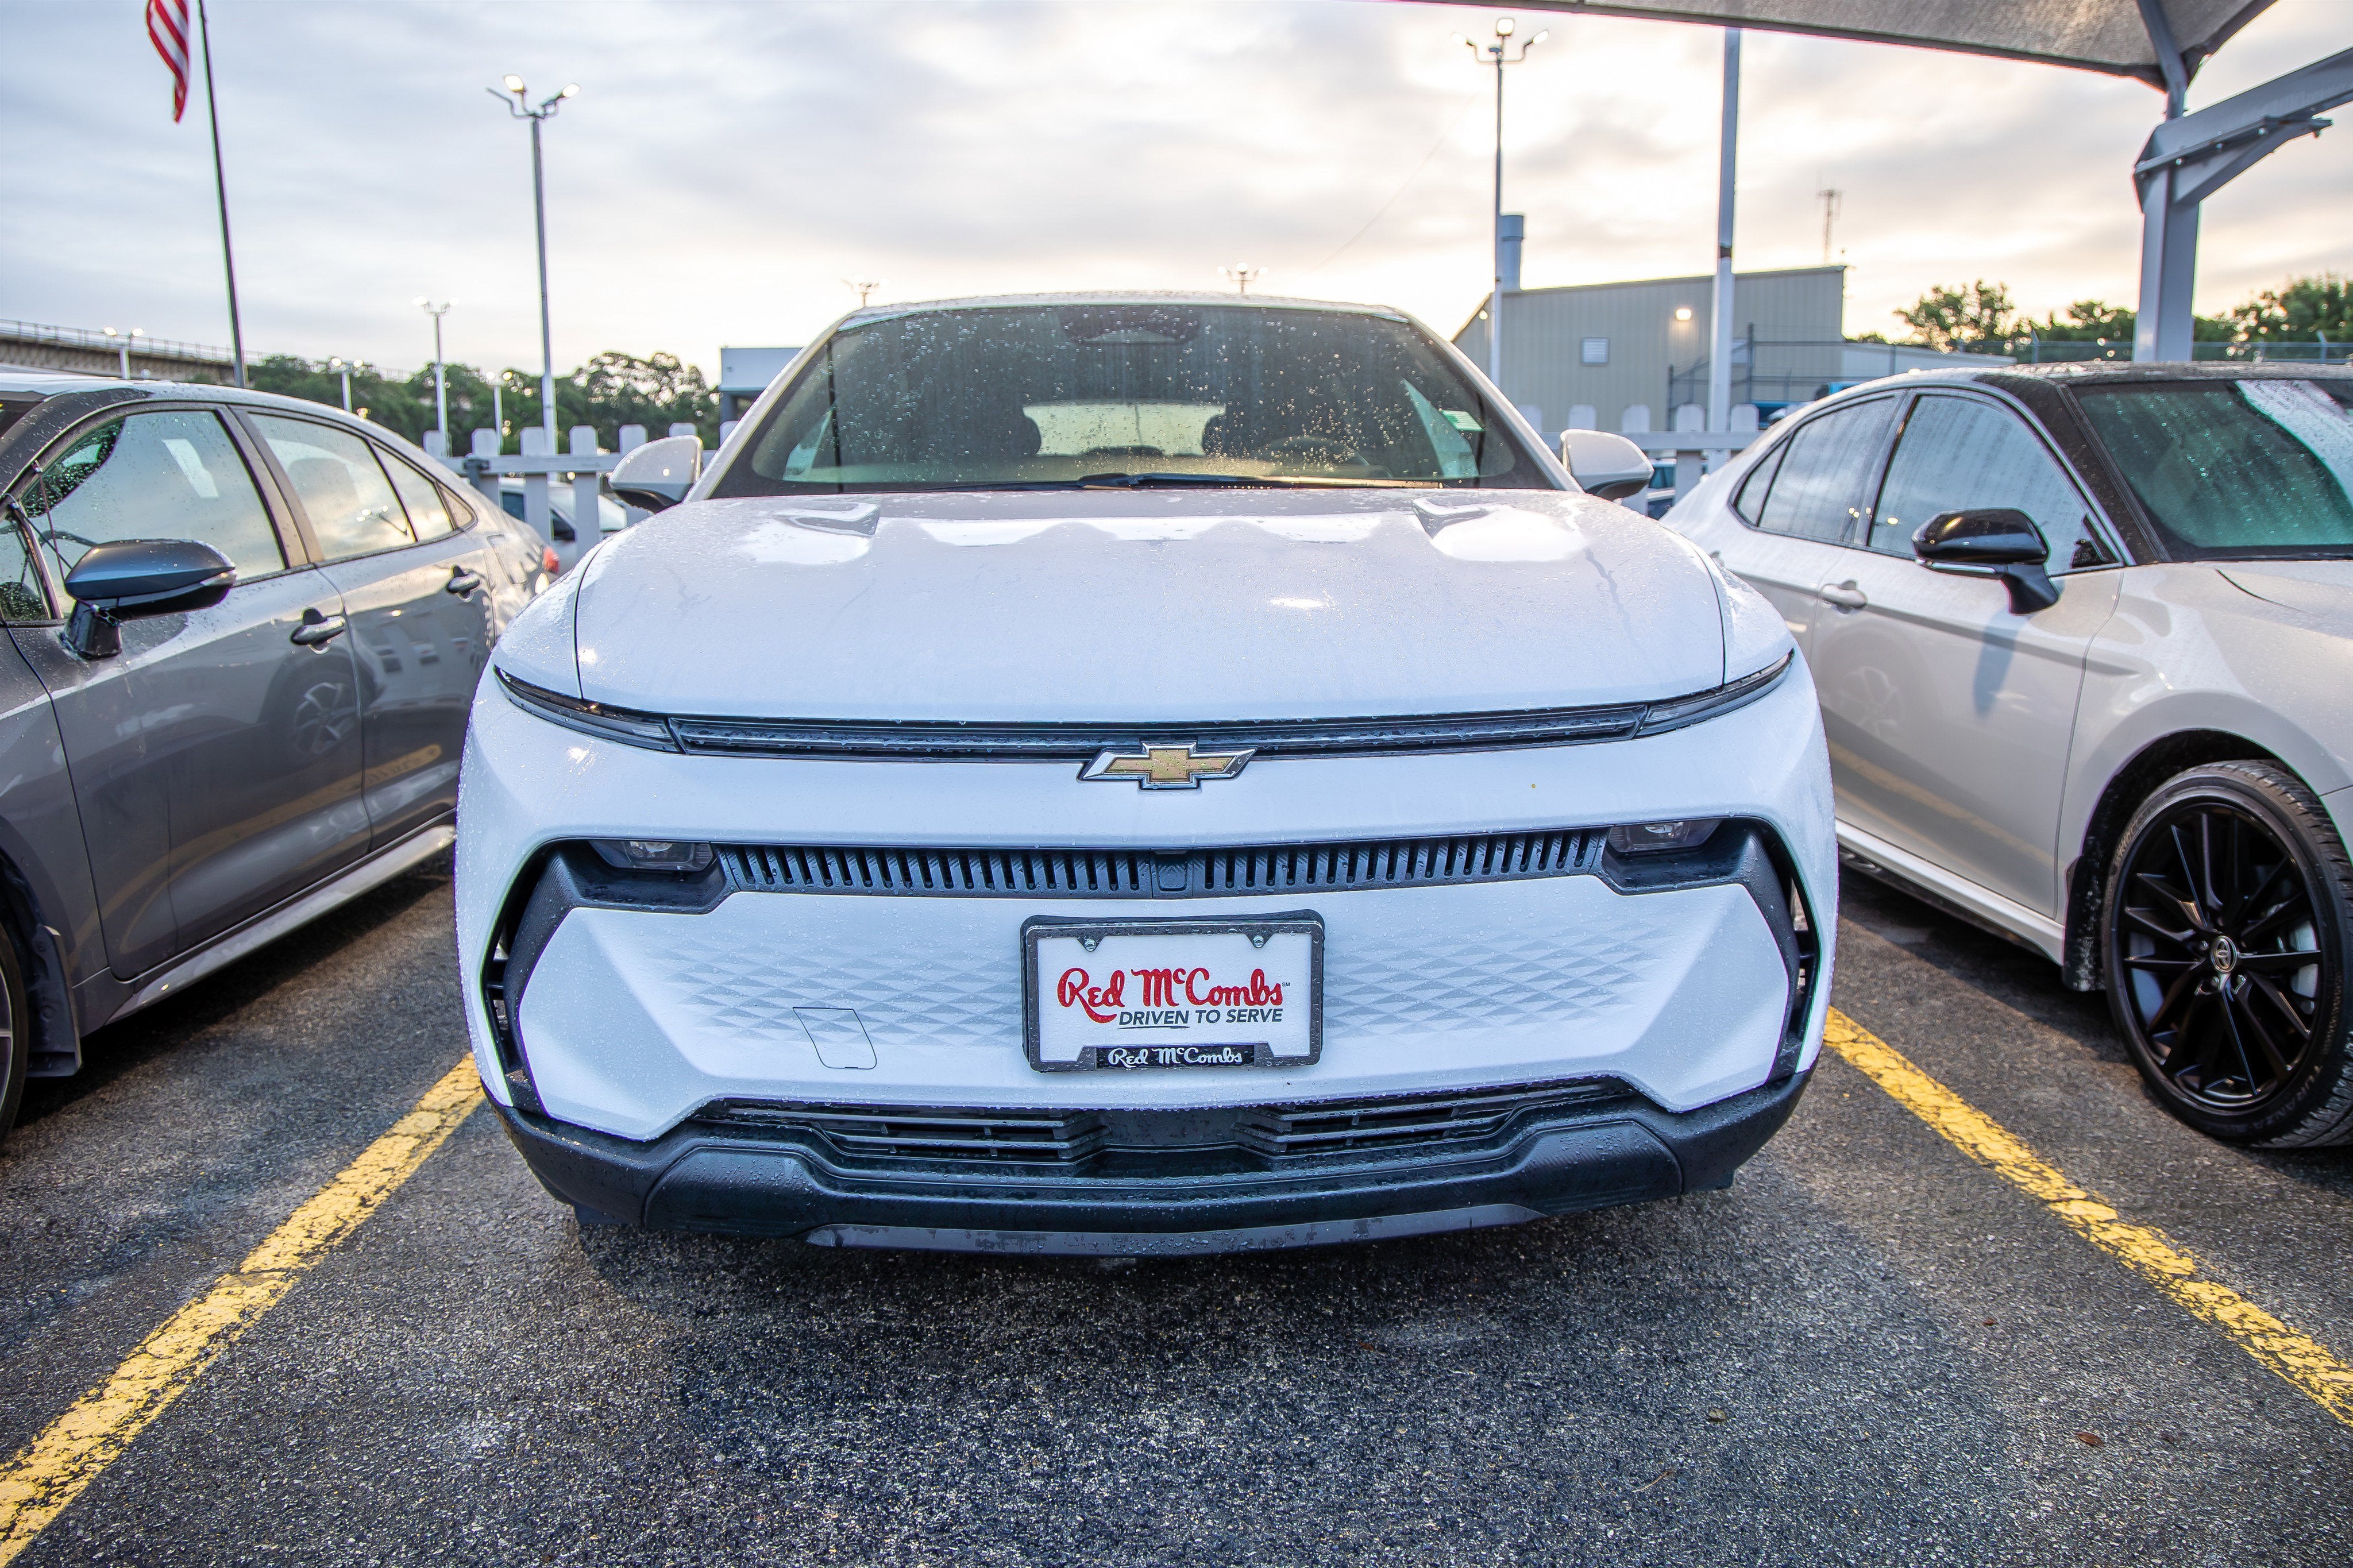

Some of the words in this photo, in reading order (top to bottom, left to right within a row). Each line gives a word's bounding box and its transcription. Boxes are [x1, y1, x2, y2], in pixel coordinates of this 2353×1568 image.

[1057, 968, 1125, 1024] Red
[1131, 968, 1283, 1007] McCombs
[1119, 1010, 1190, 1025] DRIVEN
[1195, 1009, 1221, 1024] TO
[1225, 1008, 1283, 1023] SERVE
[1108, 1048, 1148, 1068] Red
[1151, 1047, 1243, 1064] McCombs
[2253, 1064, 2324, 1130] TURANZA
